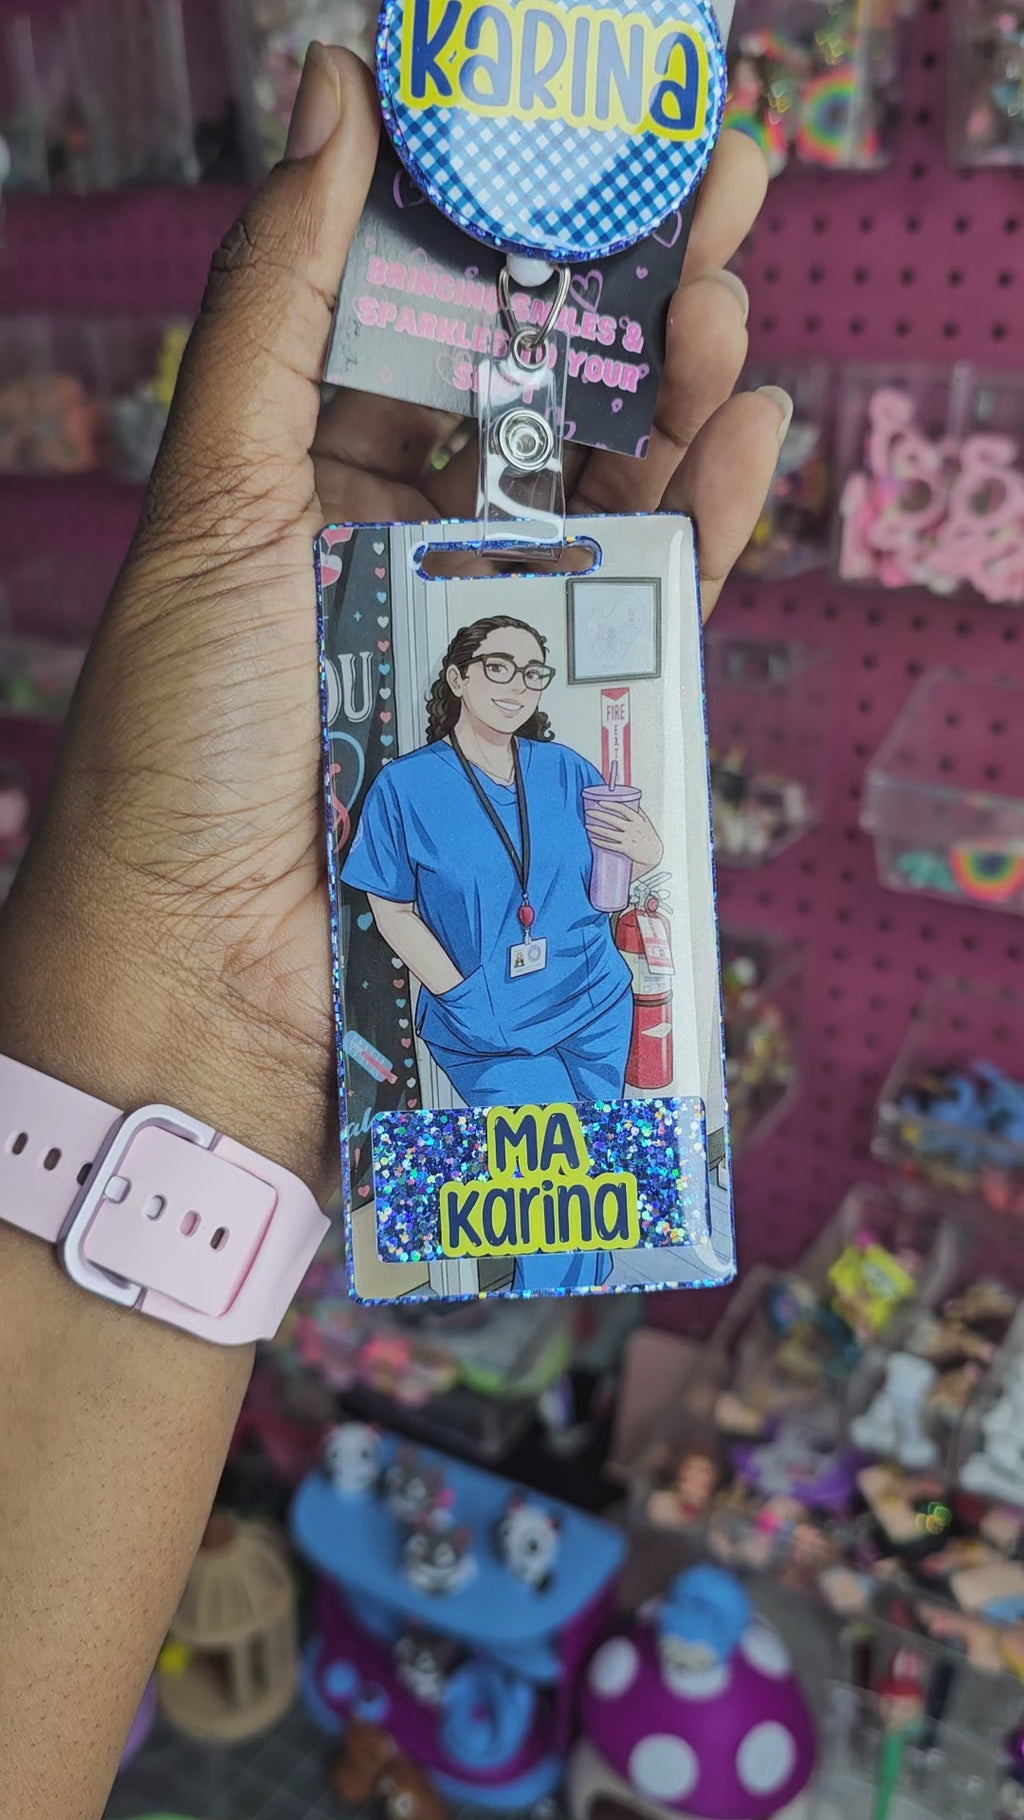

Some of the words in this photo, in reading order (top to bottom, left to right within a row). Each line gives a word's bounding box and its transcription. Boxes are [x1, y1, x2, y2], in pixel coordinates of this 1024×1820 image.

[355, 295, 510, 359] SPARKLES
[567, 348, 640, 394] YOUR
[367, 255, 501, 315] BRINGING
[621, 321, 645, 355] &
[606, 704, 625, 721] FIRE
[494, 1112, 580, 1173] MA
